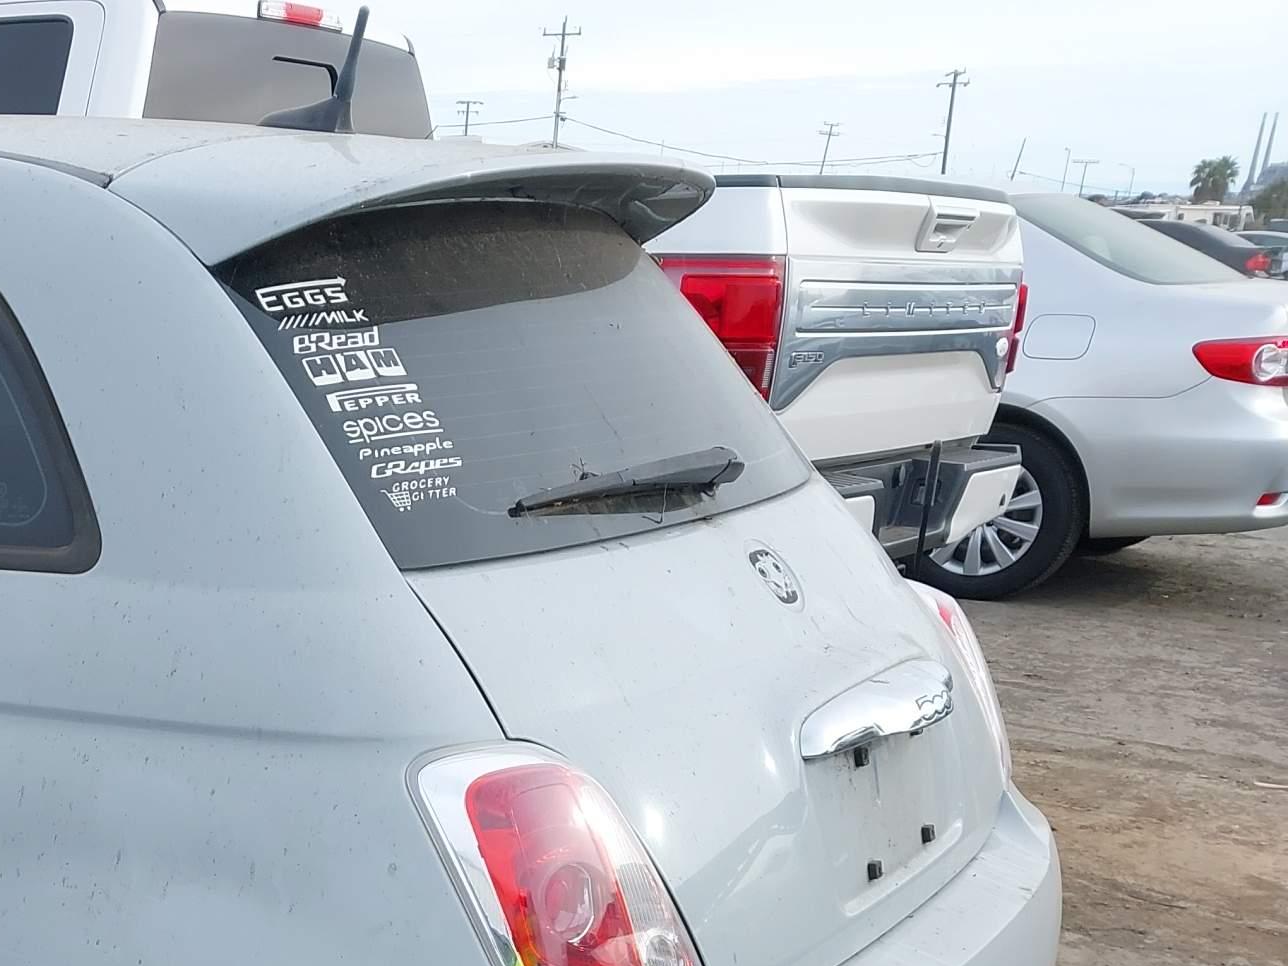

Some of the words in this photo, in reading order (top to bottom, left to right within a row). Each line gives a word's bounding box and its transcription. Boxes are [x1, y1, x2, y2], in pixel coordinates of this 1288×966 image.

[255, 276, 348, 311] EGGS
[302, 348, 407, 386] HAM
[326, 384, 422, 412] PEPPER
[359, 436, 454, 460] Pineapple
[392, 475, 450, 492] GROCERY
